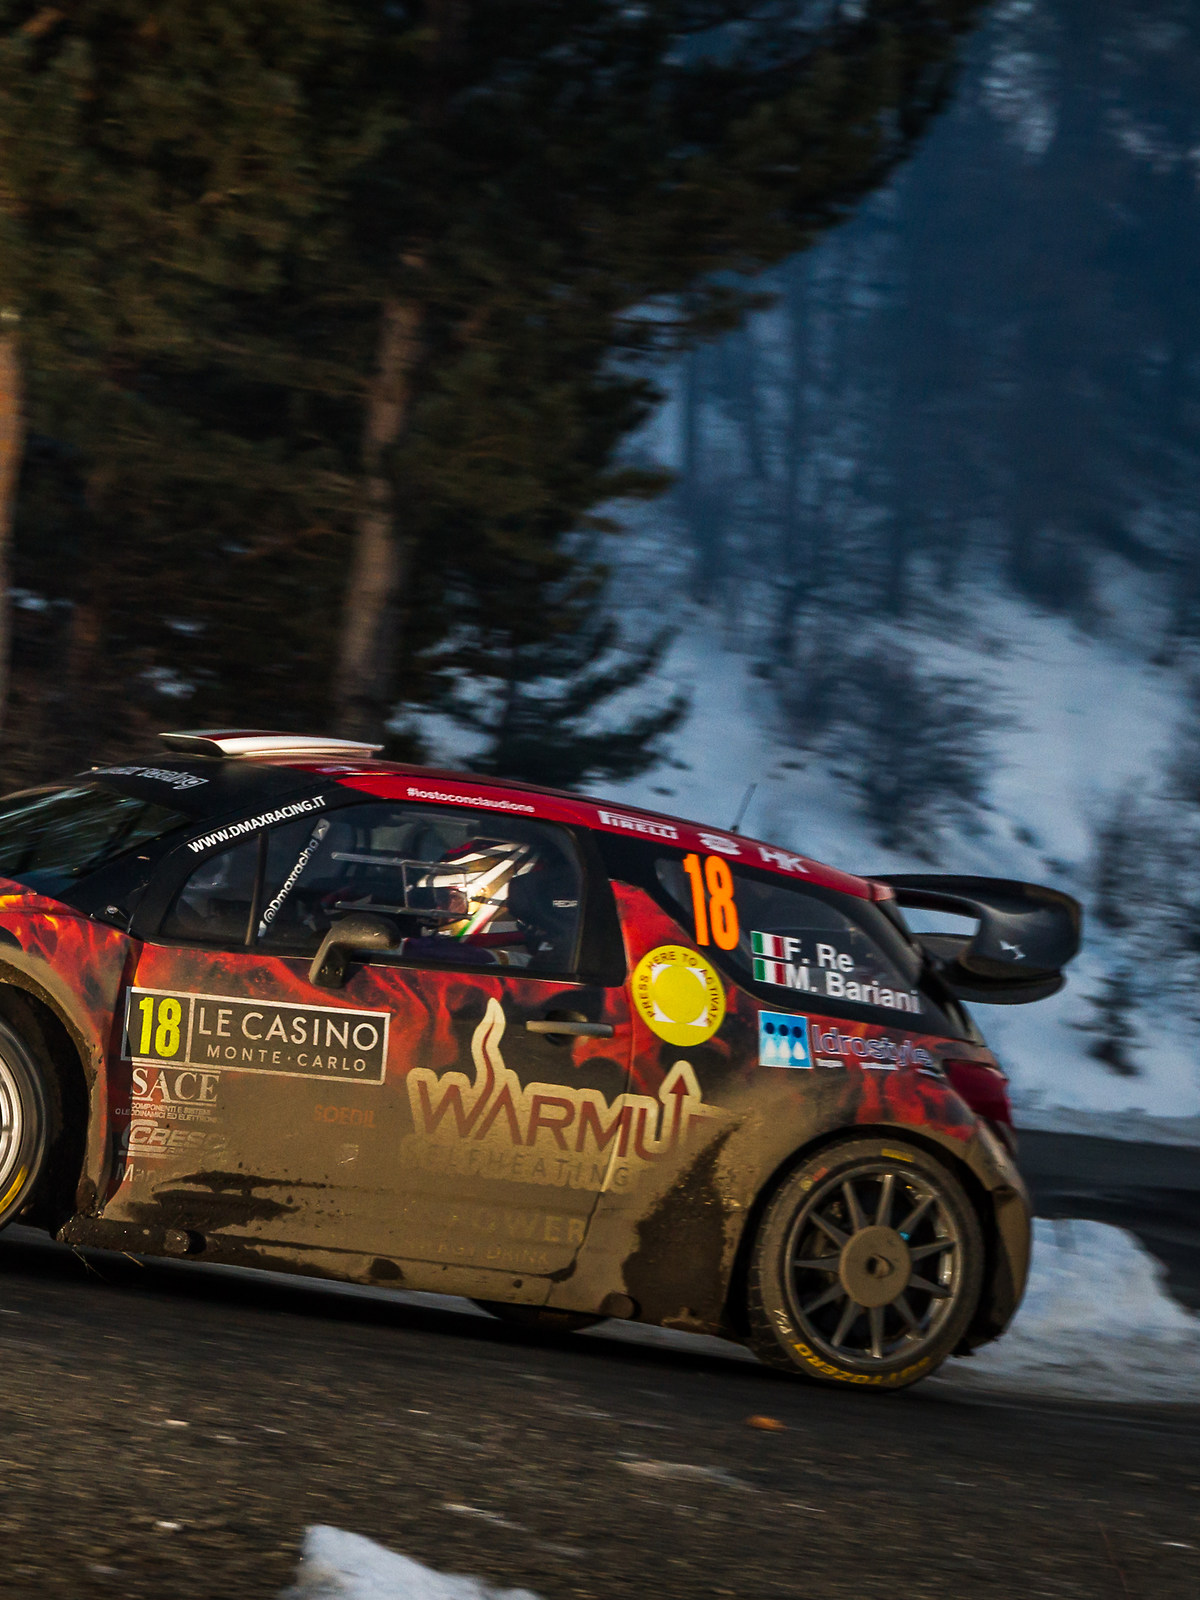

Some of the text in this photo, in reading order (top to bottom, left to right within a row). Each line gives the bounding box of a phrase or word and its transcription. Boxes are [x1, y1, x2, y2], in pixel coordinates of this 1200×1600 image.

[188, 795, 326, 853] WWW.DMAXRACING.IT
[597, 810, 679, 840] PIRELLI
[264, 839, 319, 923] @Dmaxracing
[683, 852, 740, 950] 18
[646, 951, 676, 969] HERE
[682, 953, 698, 967] TO
[784, 936, 854, 972] F. Re
[638, 975, 656, 1018] PRESS
[786, 963, 924, 1014] M. Bariani
[139, 997, 378, 1057] 18 LE CASINO
[811, 1024, 933, 1067] Idrostyle
[131, 1067, 220, 1103] SACE
